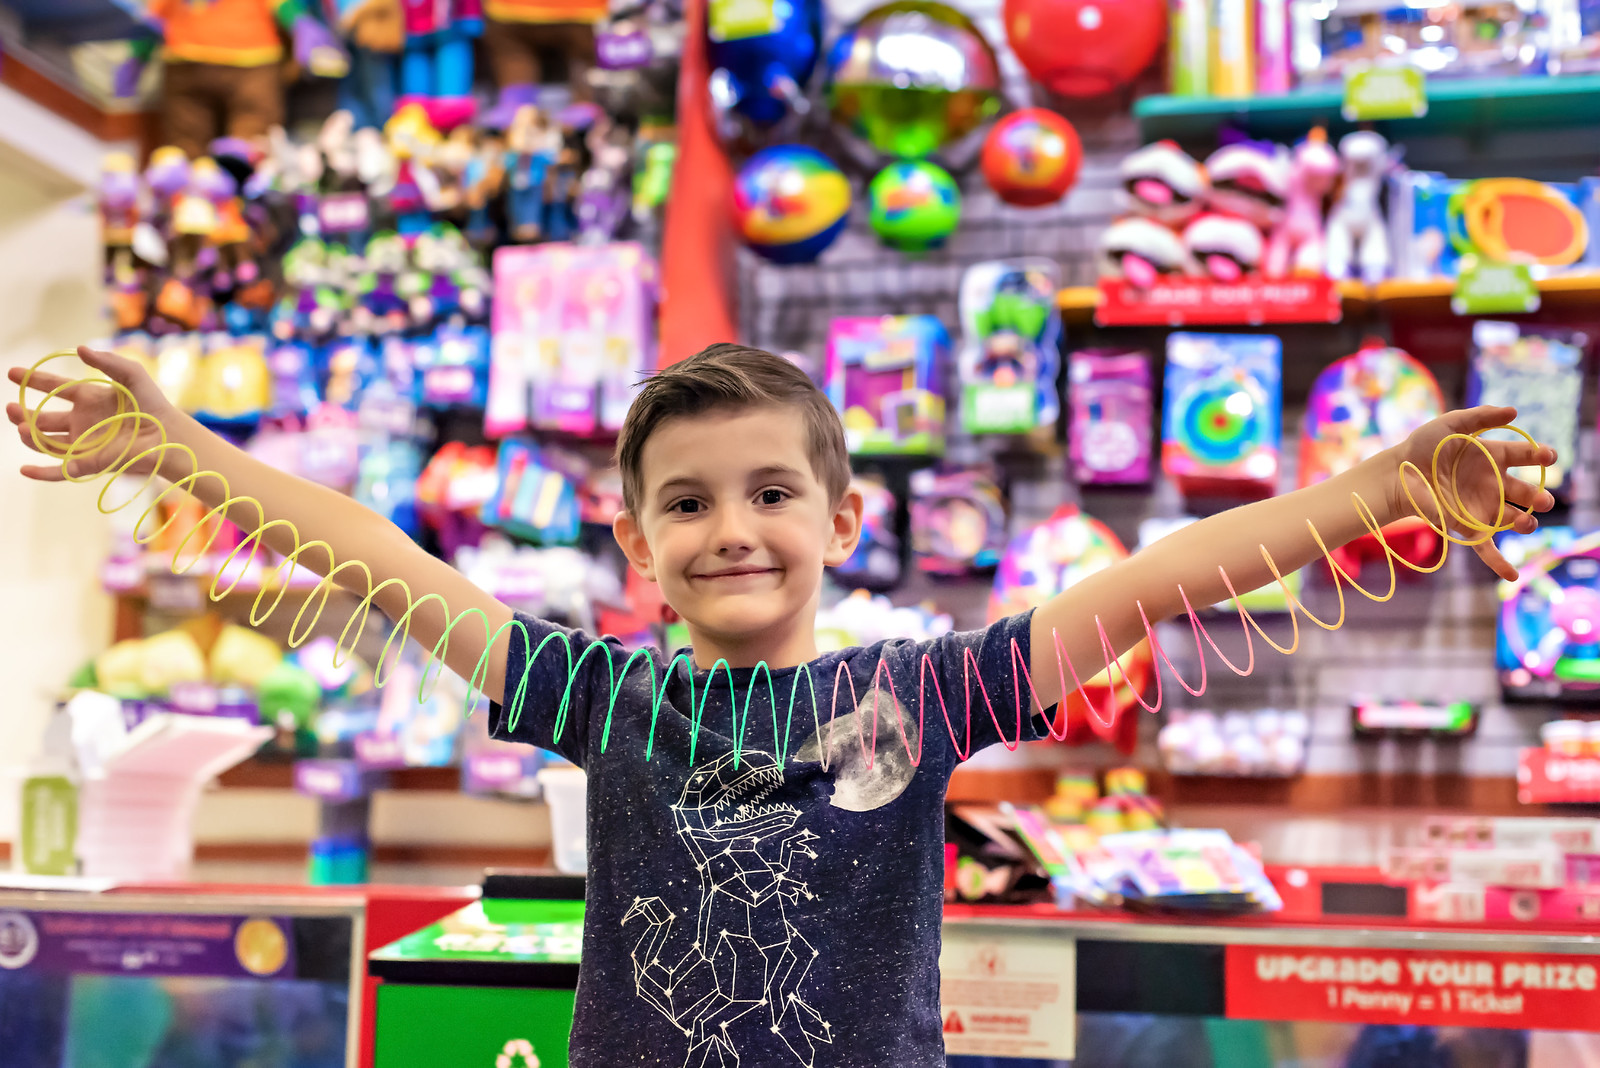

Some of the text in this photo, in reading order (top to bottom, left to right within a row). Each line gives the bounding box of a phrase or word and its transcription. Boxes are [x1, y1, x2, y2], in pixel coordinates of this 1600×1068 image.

[1408, 958, 1495, 987] YOUR
[1328, 986, 1338, 1007] 1
[1342, 989, 1413, 1015] Penny
[1441, 990, 1451, 1011] 1
[1458, 991, 1524, 1013] Ticket
